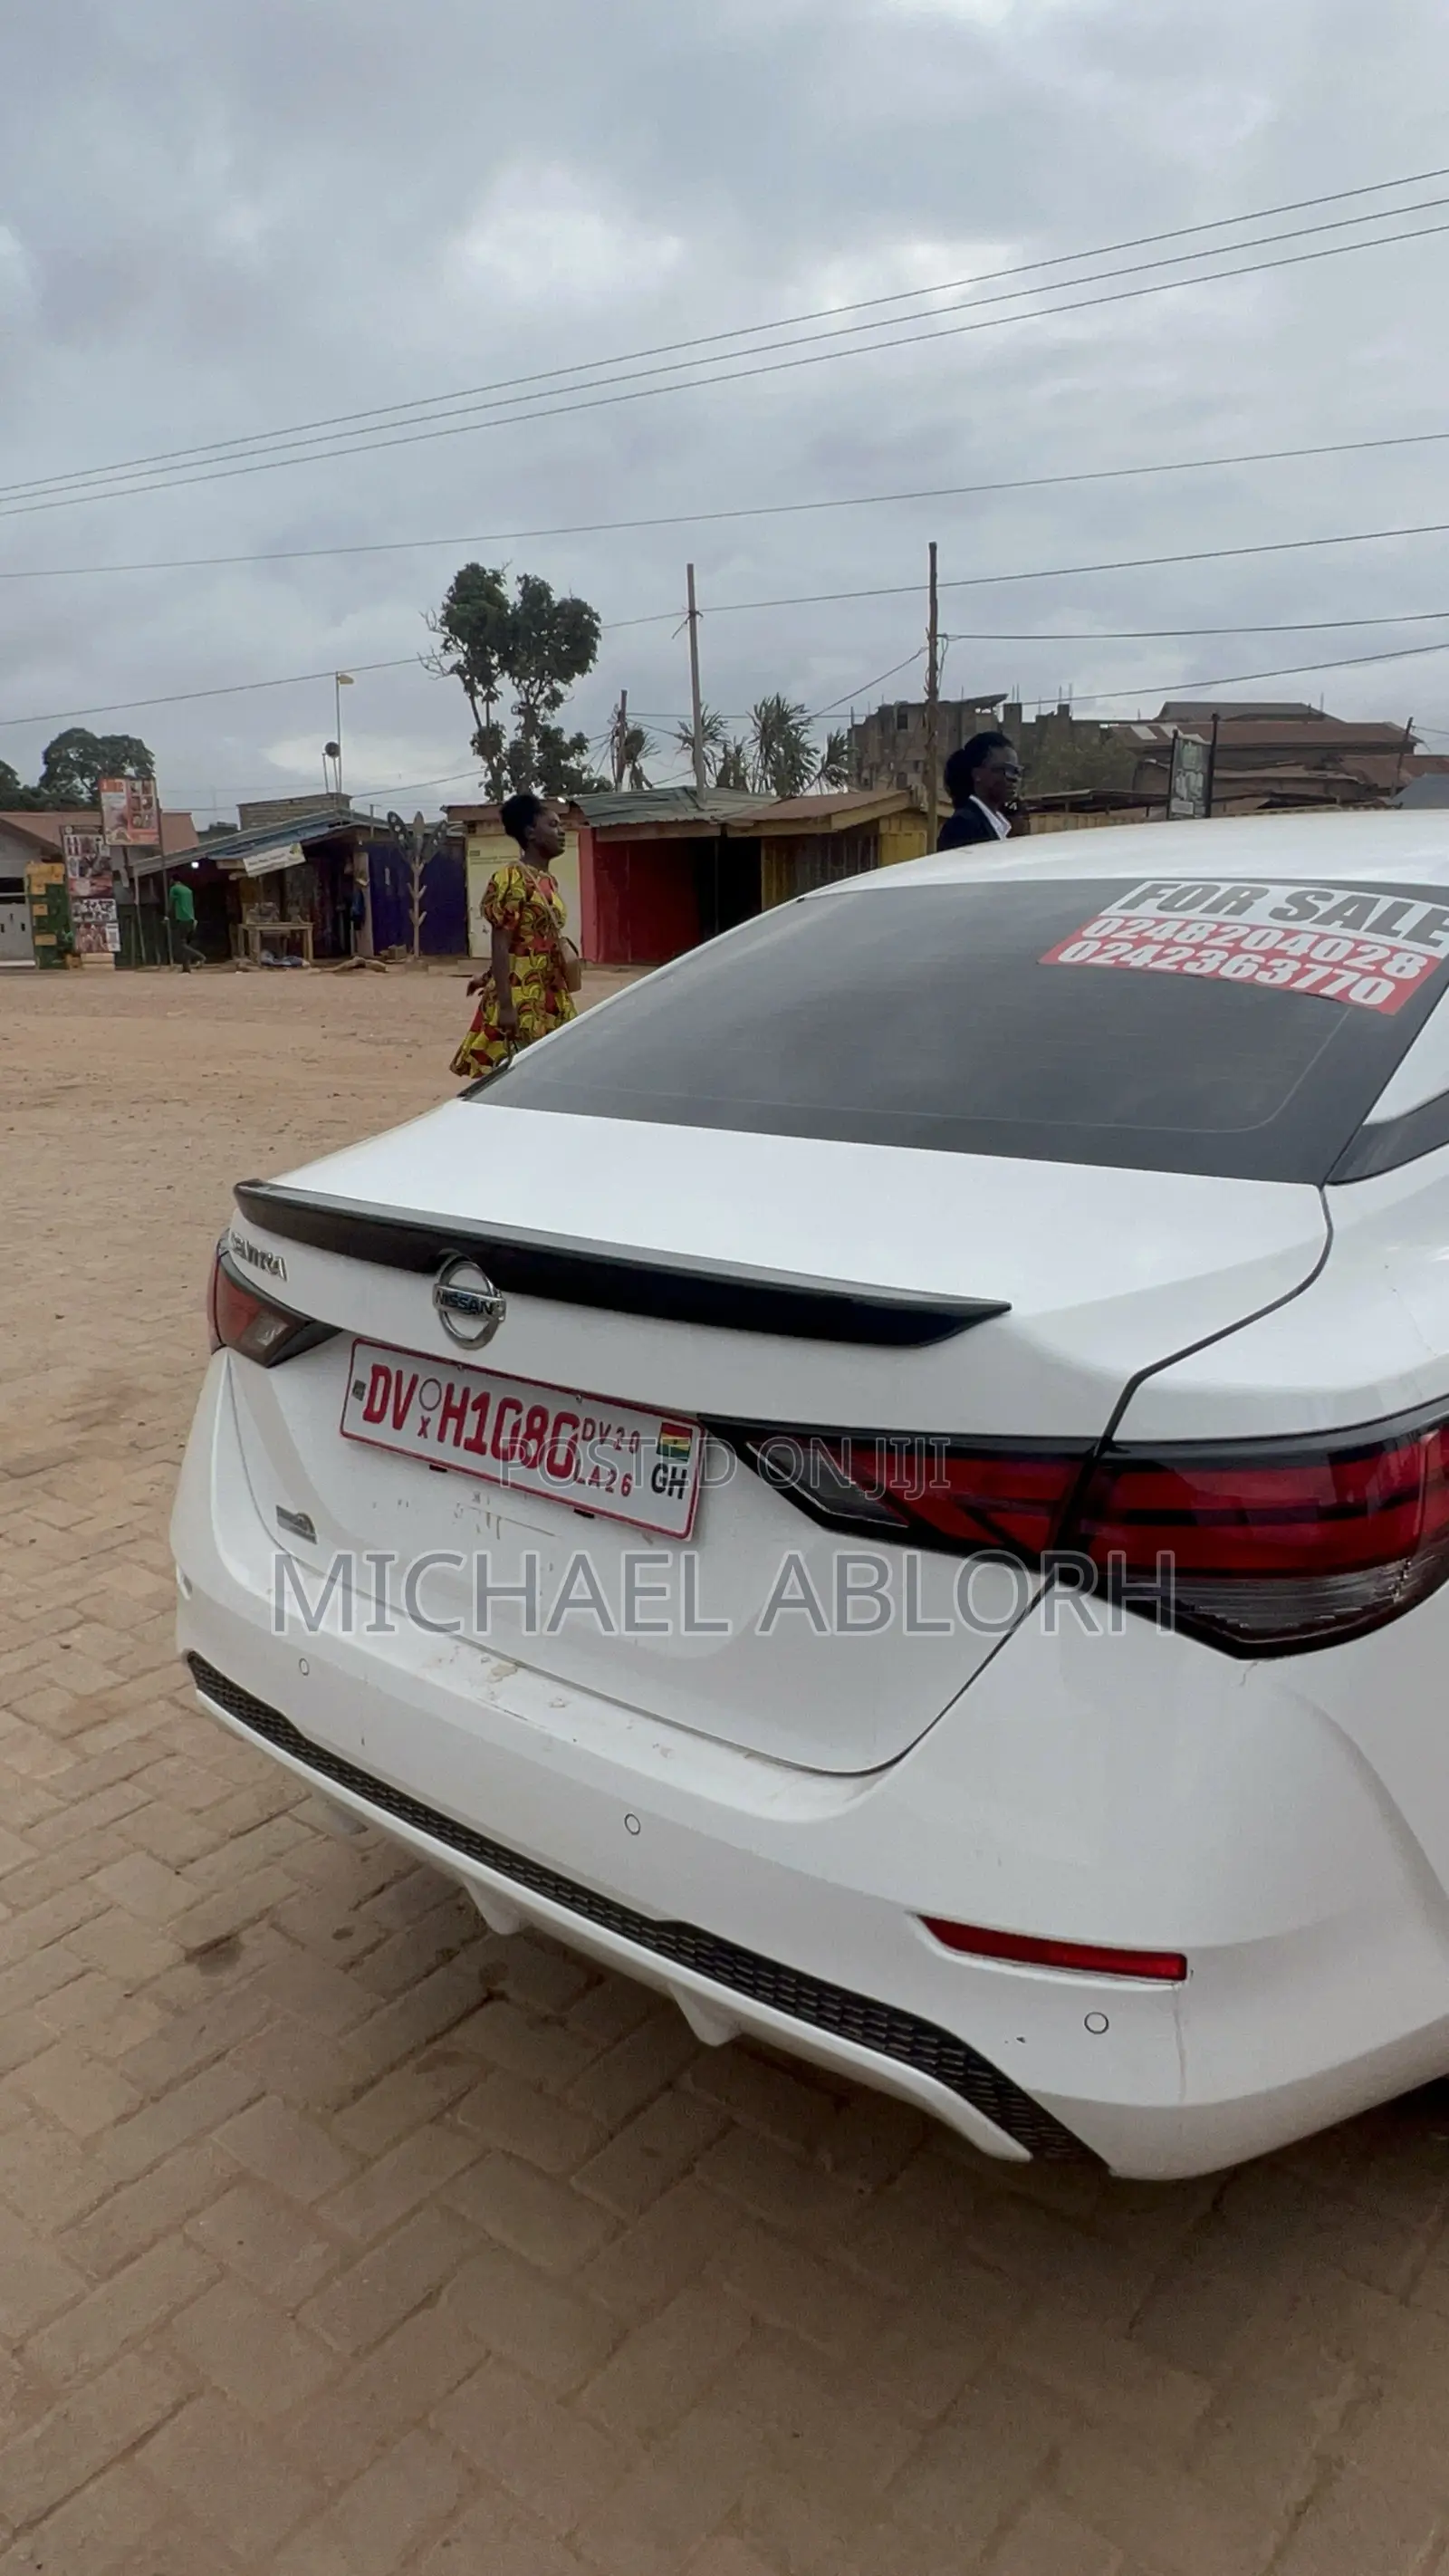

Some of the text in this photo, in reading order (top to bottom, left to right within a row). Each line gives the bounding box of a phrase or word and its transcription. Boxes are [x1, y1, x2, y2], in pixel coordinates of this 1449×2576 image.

[1118, 883, 1449, 948] FOR SALE
[1058, 940, 1396, 1005] 0242363770
[1082, 917, 1428, 980] 0248204028
[435, 1288, 494, 1316] NISSAN
[363, 1363, 419, 1431] DV
[651, 1462, 687, 1500] GH
